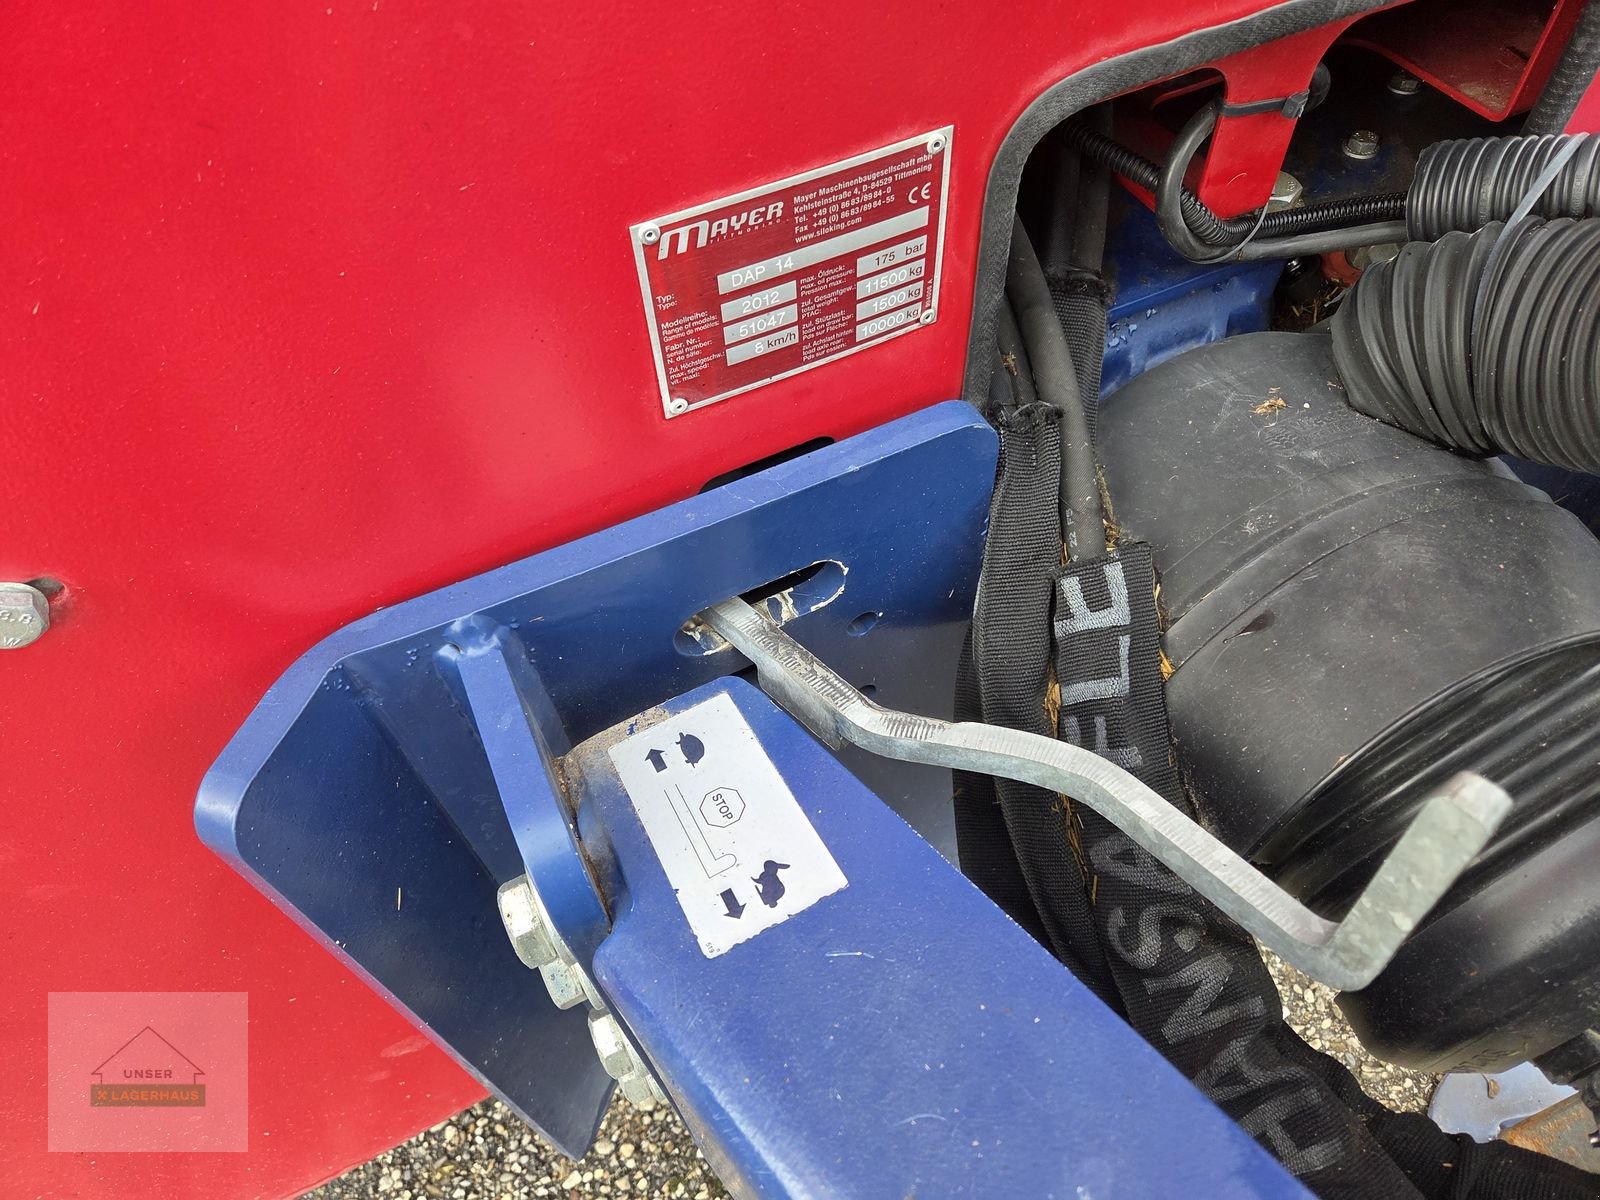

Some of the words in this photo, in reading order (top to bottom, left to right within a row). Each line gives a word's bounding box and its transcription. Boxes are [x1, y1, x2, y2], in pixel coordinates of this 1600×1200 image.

[793, 191, 816, 204] Mayer
[818, 158, 915, 196] Maschinenbaugesellschaft
[794, 190, 851, 214] Kehlsteinstraße
[853, 186, 860, 194] 4,
[862, 175, 891, 192] D-84529
[894, 163, 932, 181] Tittmoning
[794, 213, 808, 223] Tel.
[812, 207, 826, 217] +49
[829, 203, 838, 214] (0)
[795, 224, 808, 233] Fax
[812, 217, 826, 227] +49
[828, 213, 838, 224] (0)
[657, 201, 784, 261] MAYER
[795, 216, 861, 243] www.siloking.com
[875, 250, 895, 267] 175
[905, 240, 923, 256] bar
[731, 264, 766, 288] DAP
[775, 254, 794, 273] 14
[799, 275, 816, 284] max.
[817, 264, 844, 278] Öldruck:
[800, 282, 816, 290] max.
[826, 268, 854, 283] pressure:
[865, 268, 907, 294] 11500
[909, 263, 922, 278] kg
[655, 293, 674, 303] Typ:
[741, 289, 780, 314] 2012
[800, 284, 827, 297] Pression
[801, 298, 812, 307] zul.
[814, 283, 856, 302] Gesamtgew.:
[872, 290, 905, 313] 1500
[908, 286, 920, 299] kg
[657, 300, 677, 310] Type:
[801, 303, 815, 313] total
[816, 296, 838, 310] weight:
[801, 308, 821, 319] PTAC:
[660, 310, 707, 330] Modellreihe:
[662, 325, 683, 338] Range
[691, 314, 717, 326] models:
[738, 310, 786, 338] 51047
[801, 320, 813, 329] zul.
[814, 309, 845, 324] Stützlast:
[802, 325, 815, 335] load
[825, 317, 840, 326] draw
[841, 313, 853, 321] bar:
[862, 311, 904, 337] 10000
[906, 306, 919, 319] kg
[664, 342, 684, 352] Fabr.
[685, 336, 700, 345] Nr.:
[754, 340, 764, 354] 8
[767, 330, 796, 349] km/h
[802, 333, 814, 341] Pds
[666, 348, 684, 358] serial
[684, 339, 712, 352] number:
[668, 365, 679, 374] Zul.
[670, 371, 685, 379] max.
[686, 362, 709, 374] speed:
[712, 793, 734, 821] STOP
